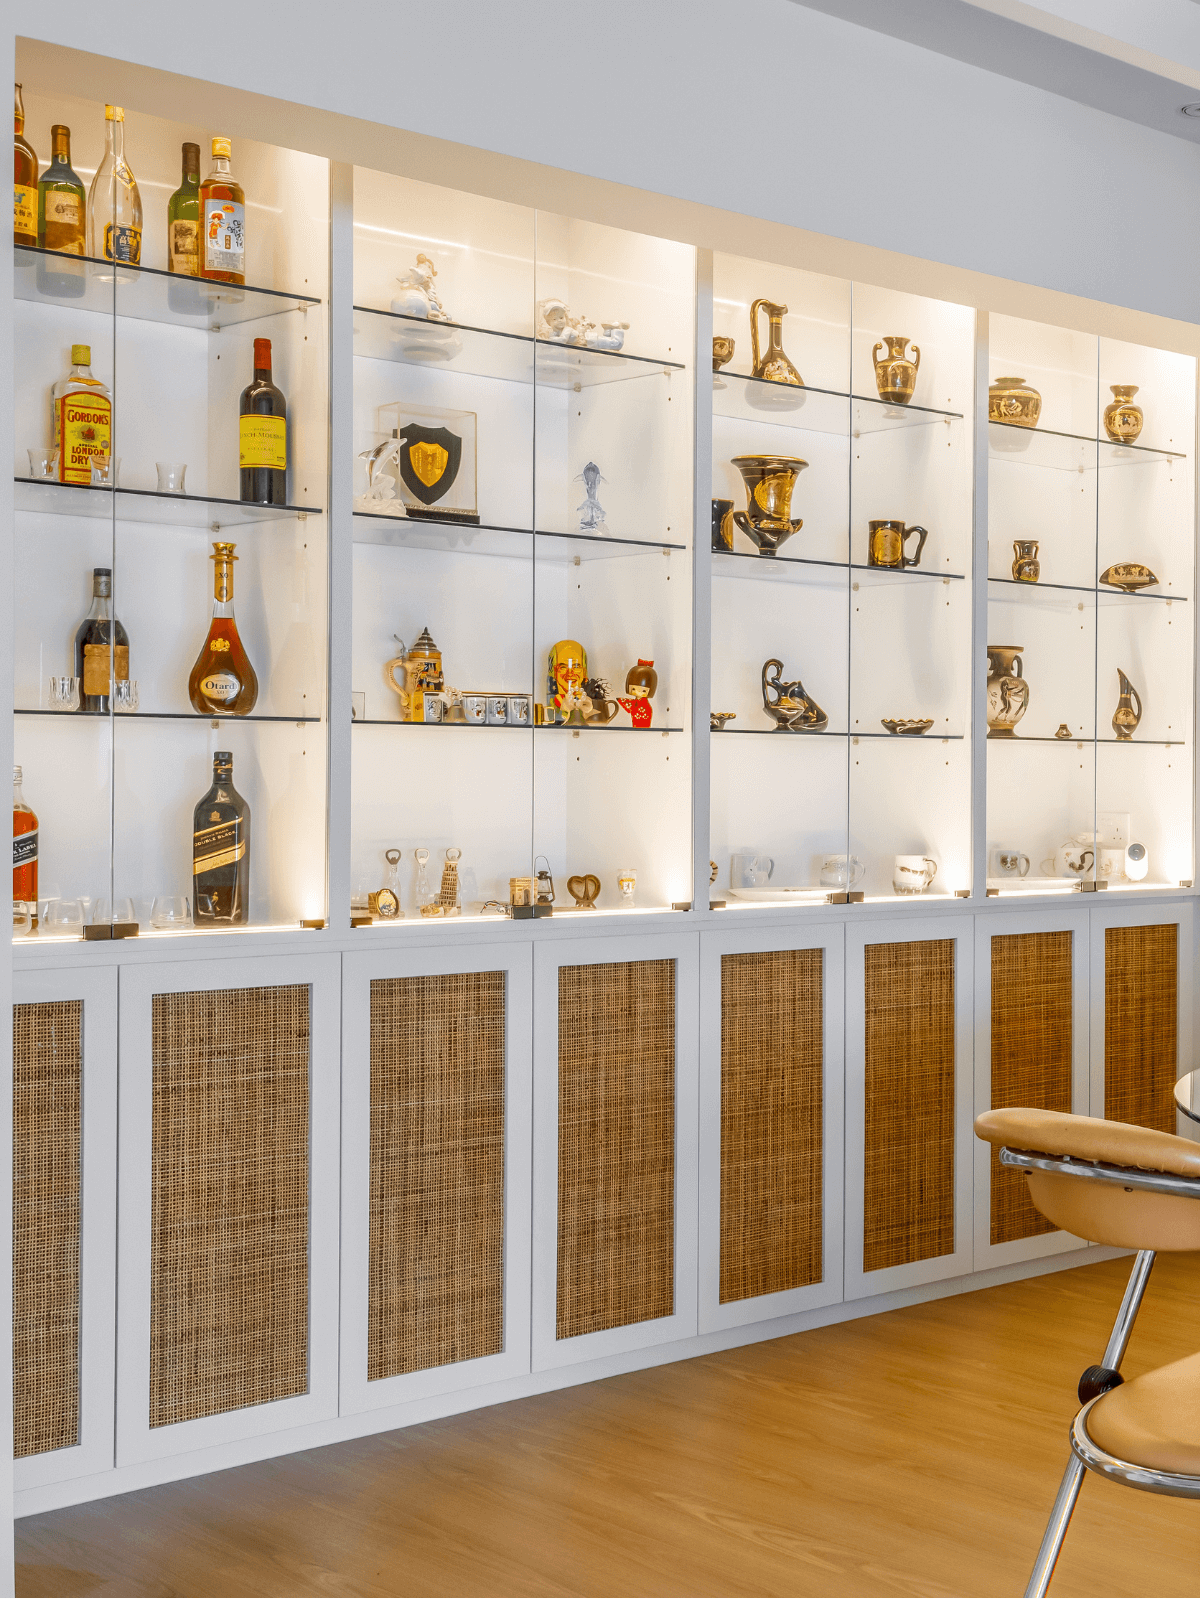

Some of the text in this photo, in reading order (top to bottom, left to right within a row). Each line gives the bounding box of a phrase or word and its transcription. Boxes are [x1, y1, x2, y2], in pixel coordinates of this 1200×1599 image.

[67, 409, 109, 425] GORDON'S
[71, 445, 105, 457] LONDON
[71, 454, 89, 466] DRY
[205, 680, 235, 690] Otard
